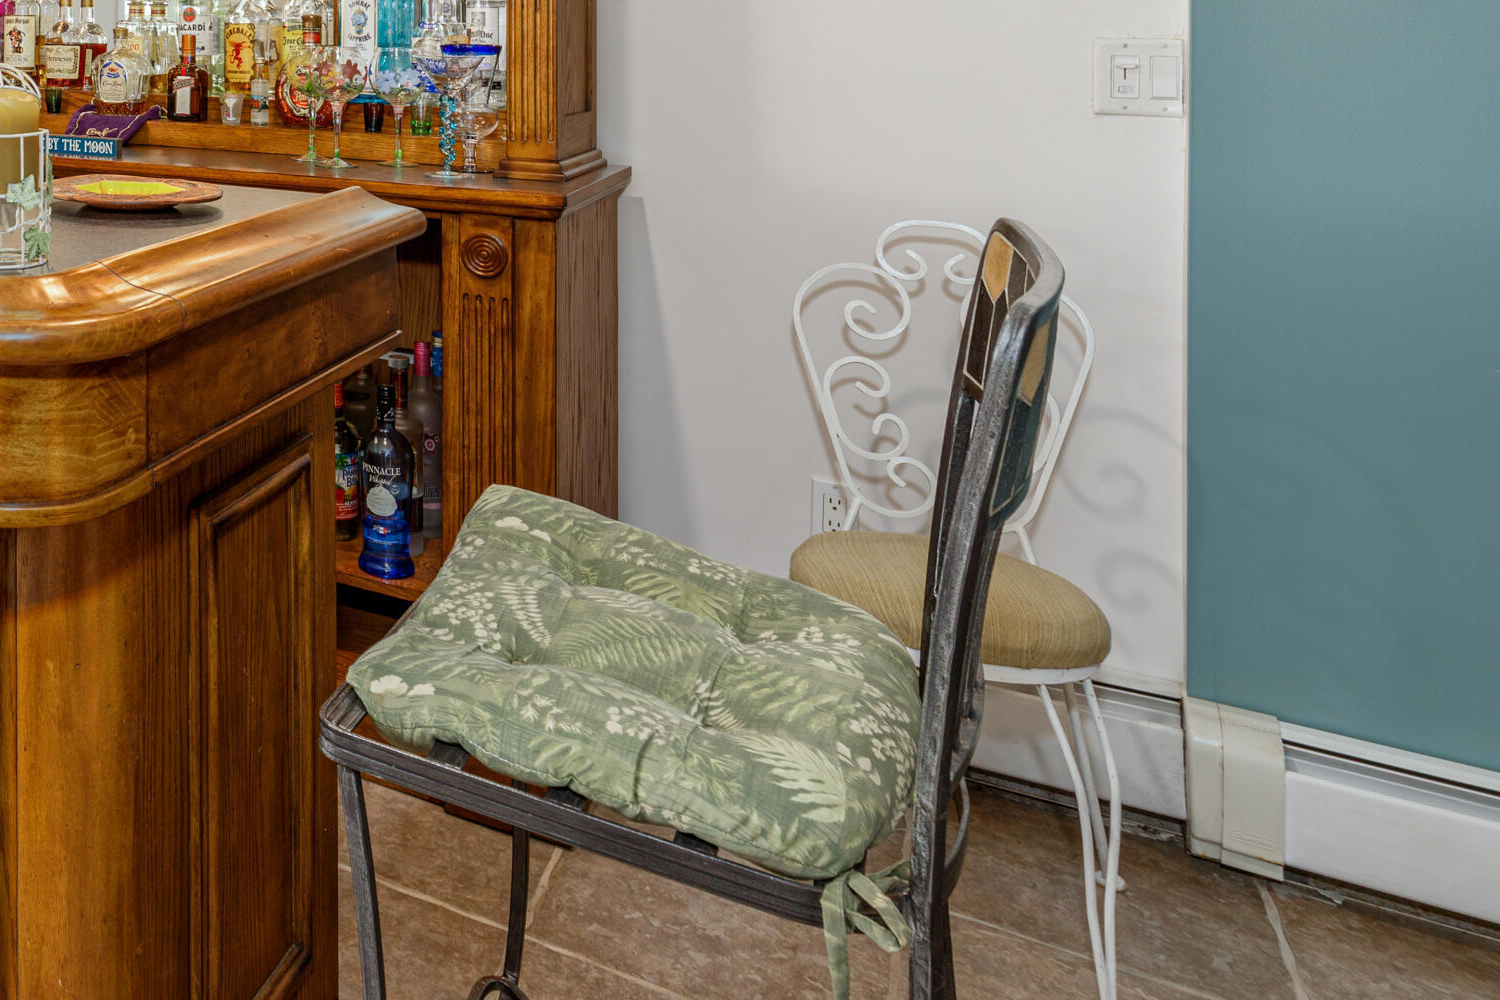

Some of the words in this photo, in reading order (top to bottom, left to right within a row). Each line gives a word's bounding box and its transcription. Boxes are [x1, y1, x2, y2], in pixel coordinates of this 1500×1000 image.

[226, 27, 253, 40] FIREBALL
[49, 137, 59, 151] BY
[62, 138, 81, 152] THE
[84, 140, 113, 155] MOON
[362, 461, 401, 476] PINNACLE
